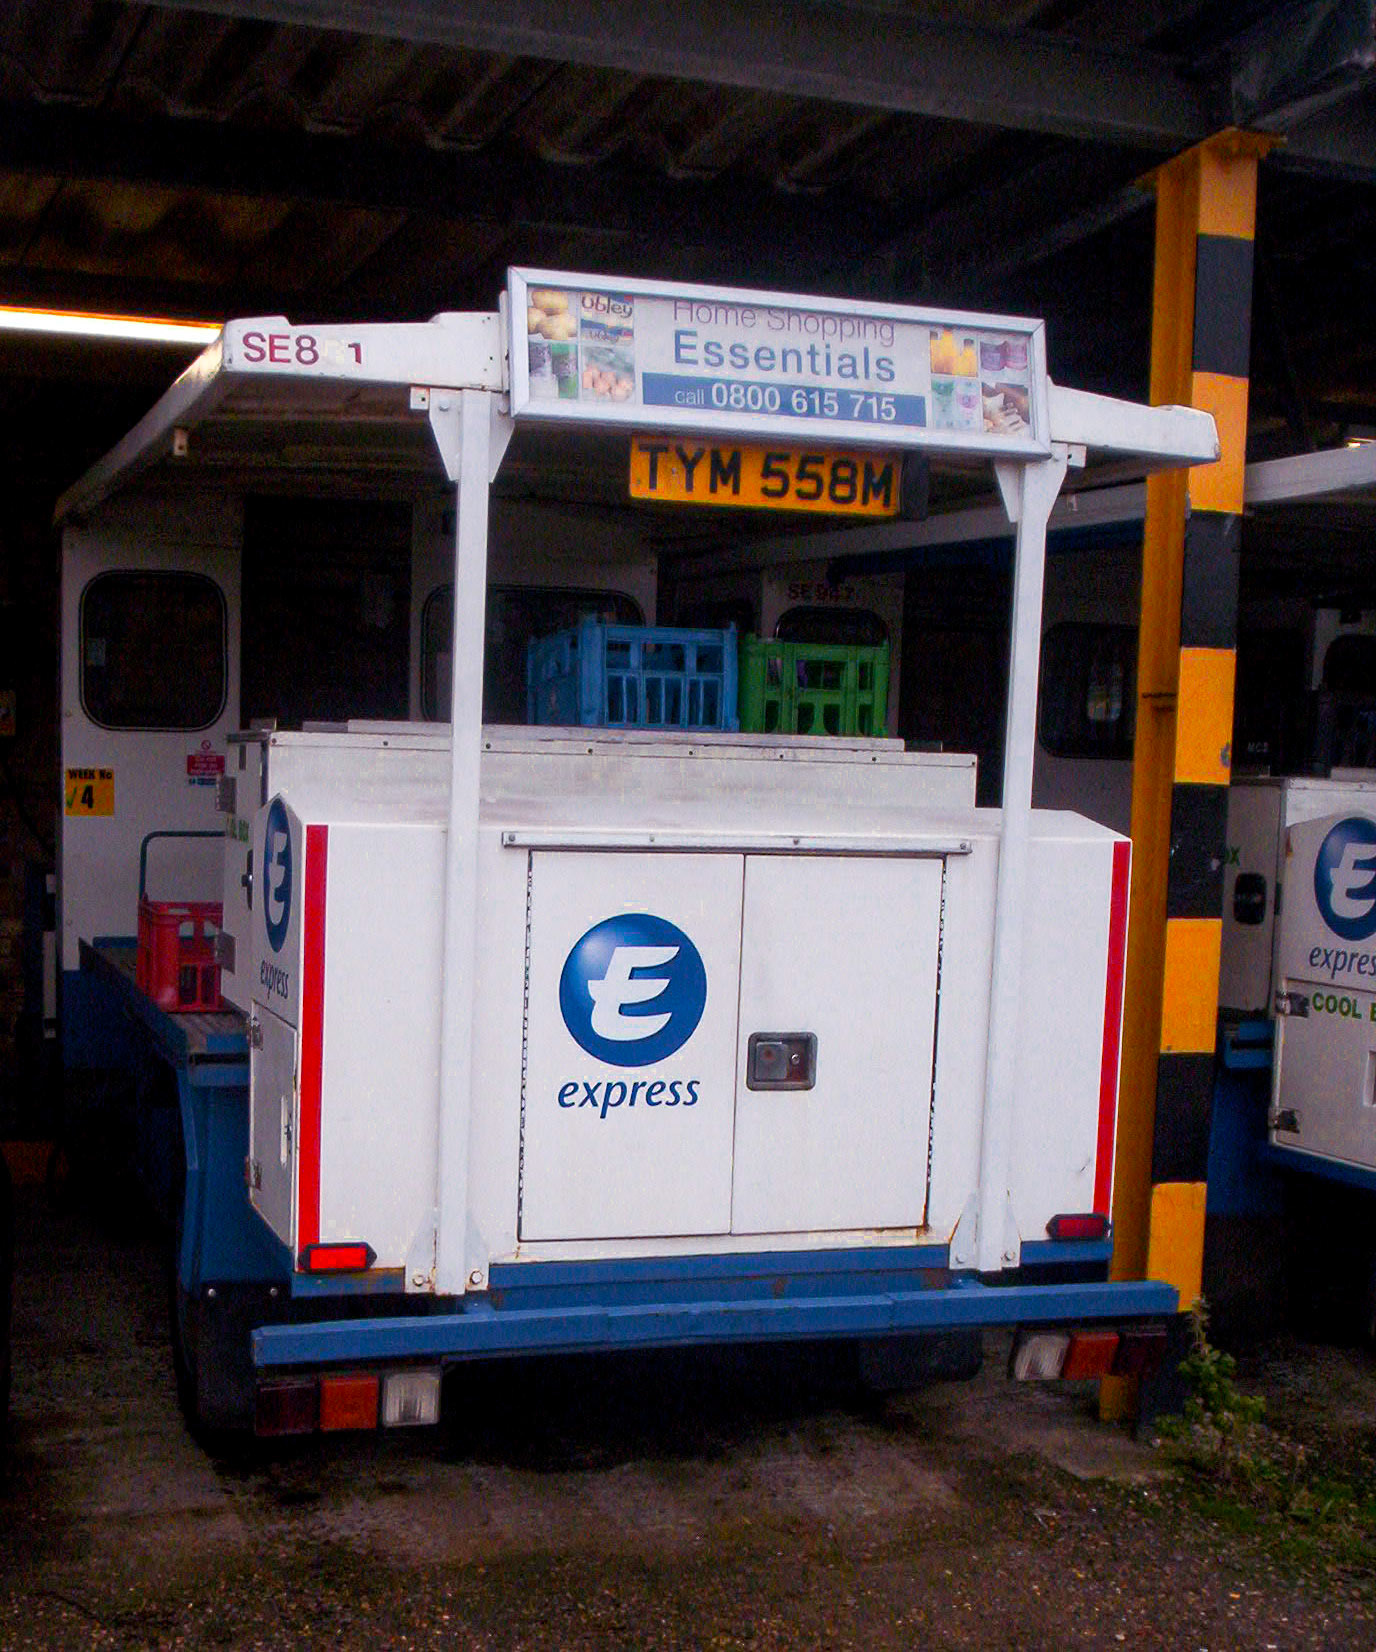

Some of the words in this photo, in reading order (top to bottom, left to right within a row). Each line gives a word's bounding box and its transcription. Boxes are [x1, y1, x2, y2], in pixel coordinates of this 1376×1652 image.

[672, 301, 757, 328] Home
[767, 308, 896, 348] Shopping
[242, 331, 320, 365] SE8
[673, 329, 897, 383] Essentials
[675, 388, 705, 406] call
[711, 382, 782, 412] 0800
[791, 388, 840, 418] 615
[850, 394, 897, 422] 715
[637, 443, 742, 496] TYM
[760, 451, 895, 508] 558M
[81, 785, 94, 809] 4
[260, 959, 289, 1000] express
[1312, 992, 1362, 1020] COOL
[558, 1078, 701, 1119] express
